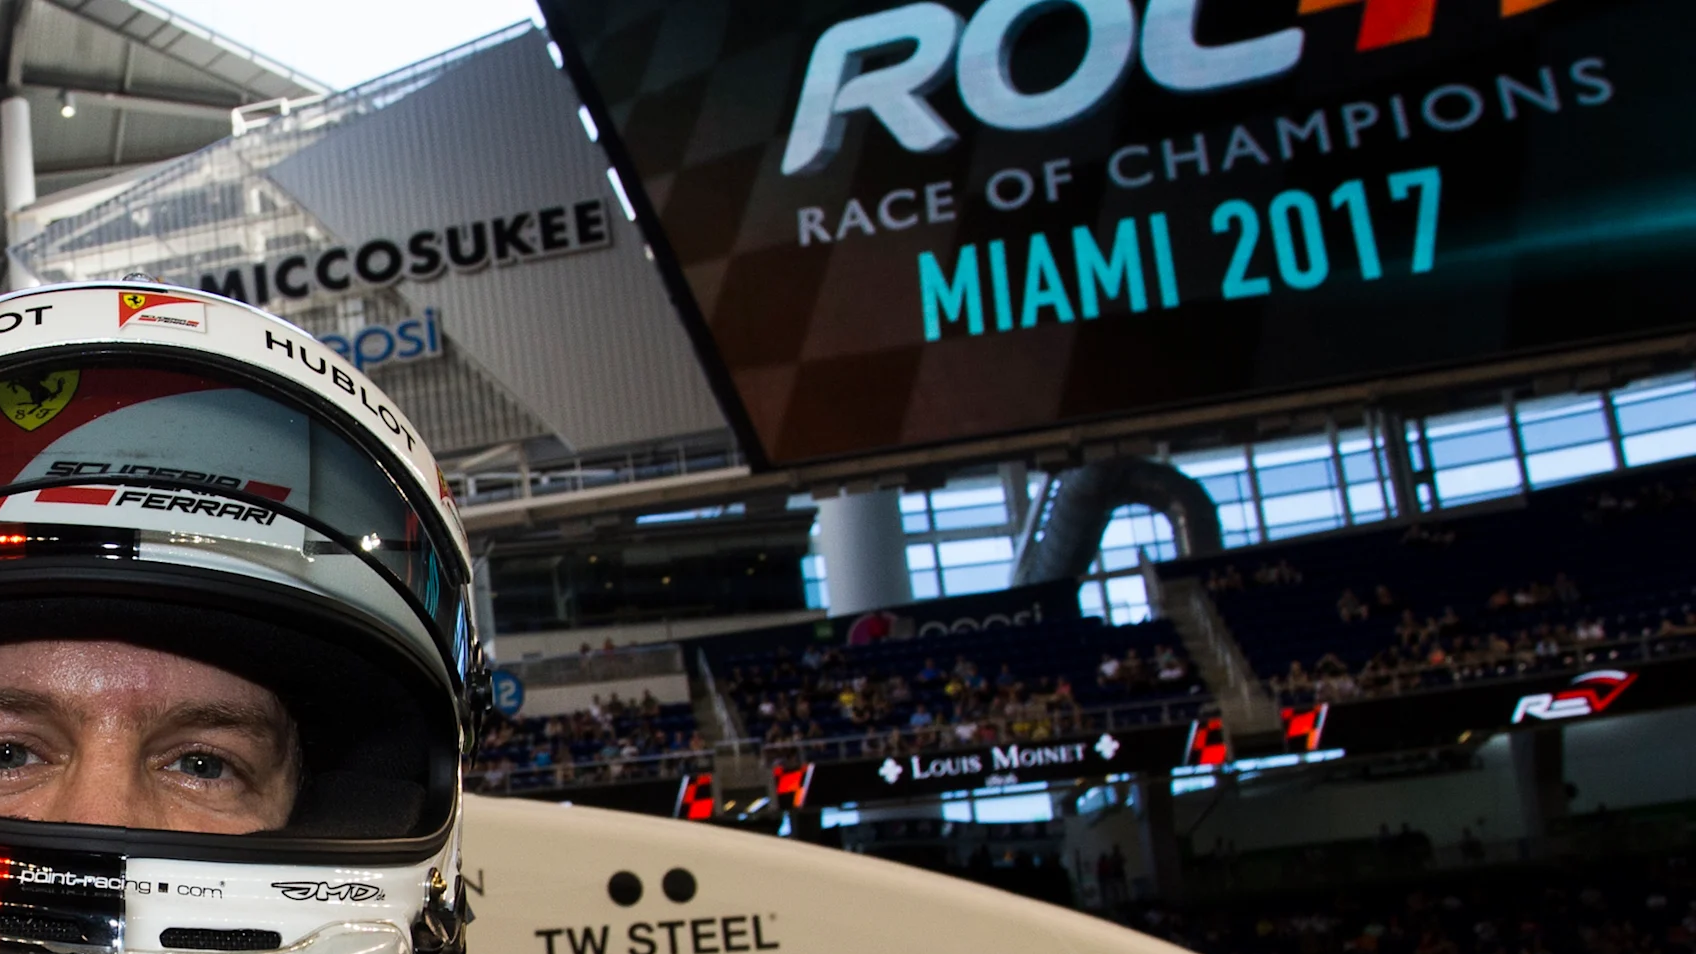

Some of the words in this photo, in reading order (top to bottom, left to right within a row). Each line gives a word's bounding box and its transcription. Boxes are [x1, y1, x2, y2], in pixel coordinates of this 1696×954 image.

[781, 0, 1304, 175] ROC
[797, 181, 957, 246] RACE
[986, 158, 1073, 212] OF
[1107, 58, 1615, 189] CHAMPIONS
[200, 201, 605, 305] MICCOSUKEE
[918, 212, 1178, 343] MIAMI
[1210, 166, 1442, 300] 2017
[264, 330, 417, 452] HUBLOT
[115, 490, 278, 525] FERRARI
